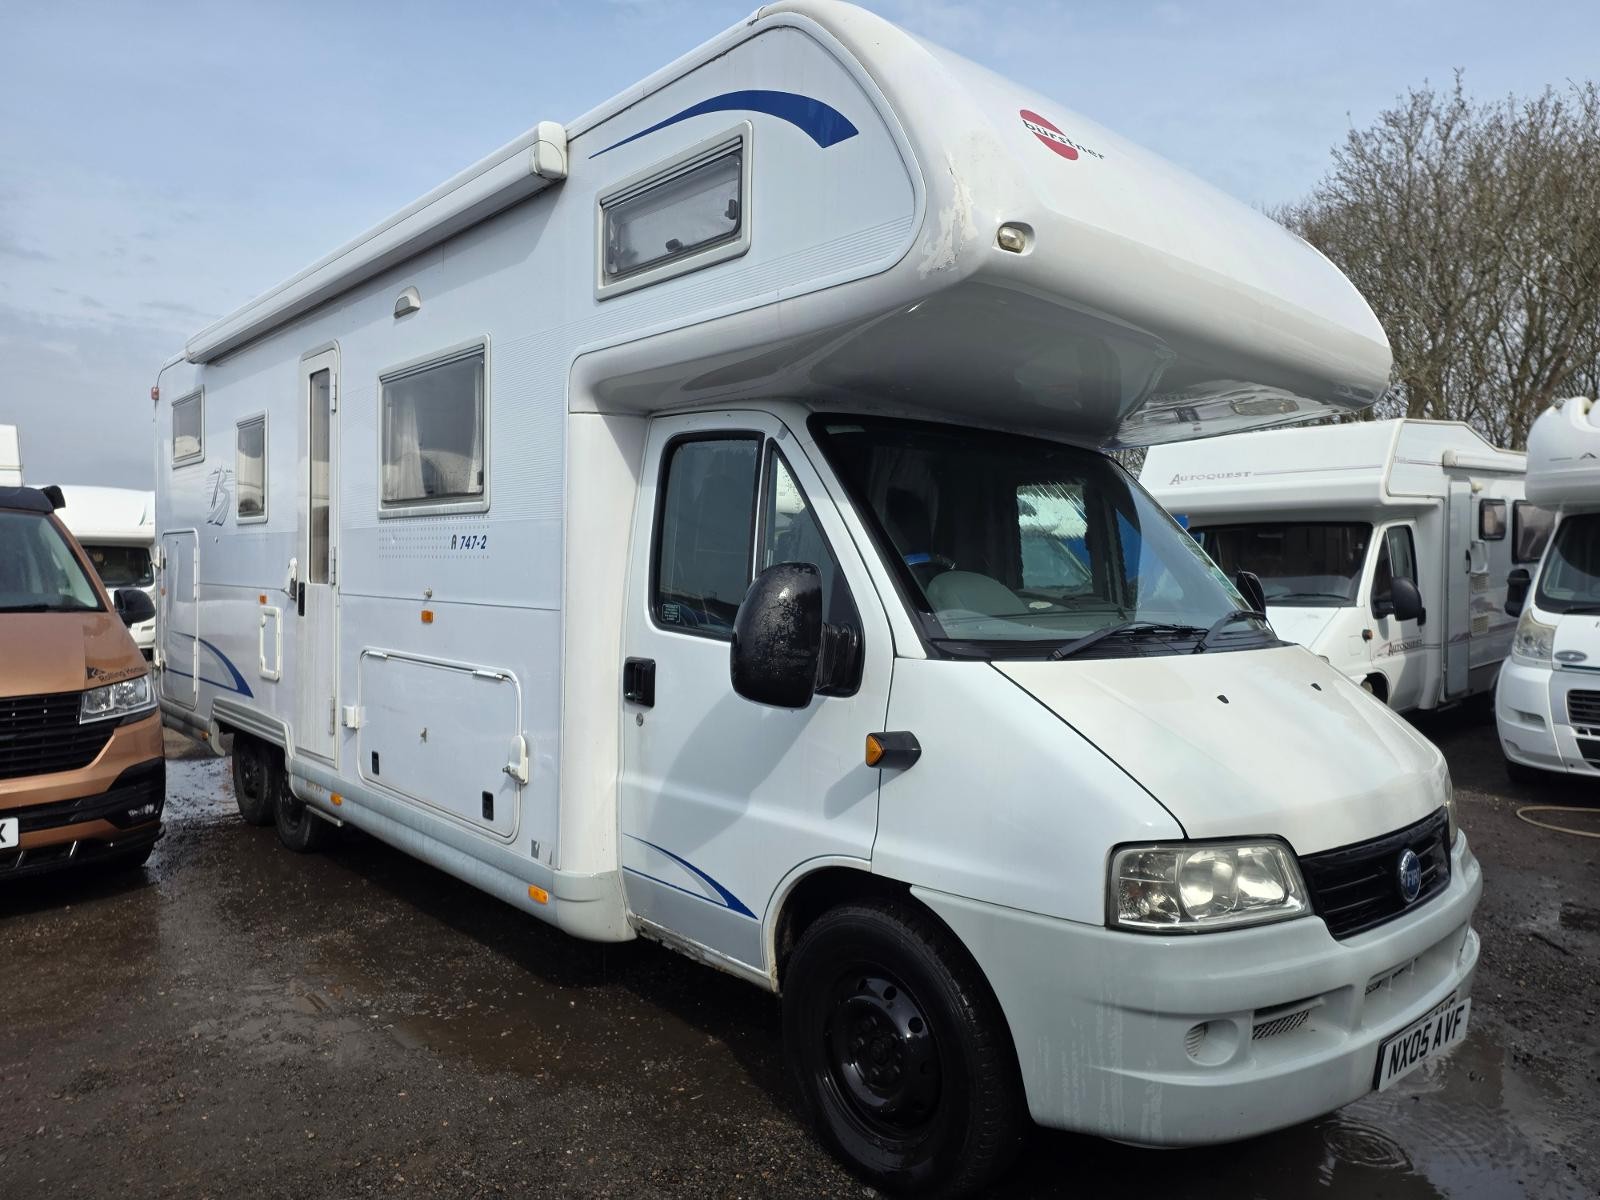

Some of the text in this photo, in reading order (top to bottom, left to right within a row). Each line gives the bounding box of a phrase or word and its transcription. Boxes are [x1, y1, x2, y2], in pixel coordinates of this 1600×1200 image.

[450, 534, 487, 550] A 747-2
[1388, 1005, 1465, 1079] NX05 AVF
